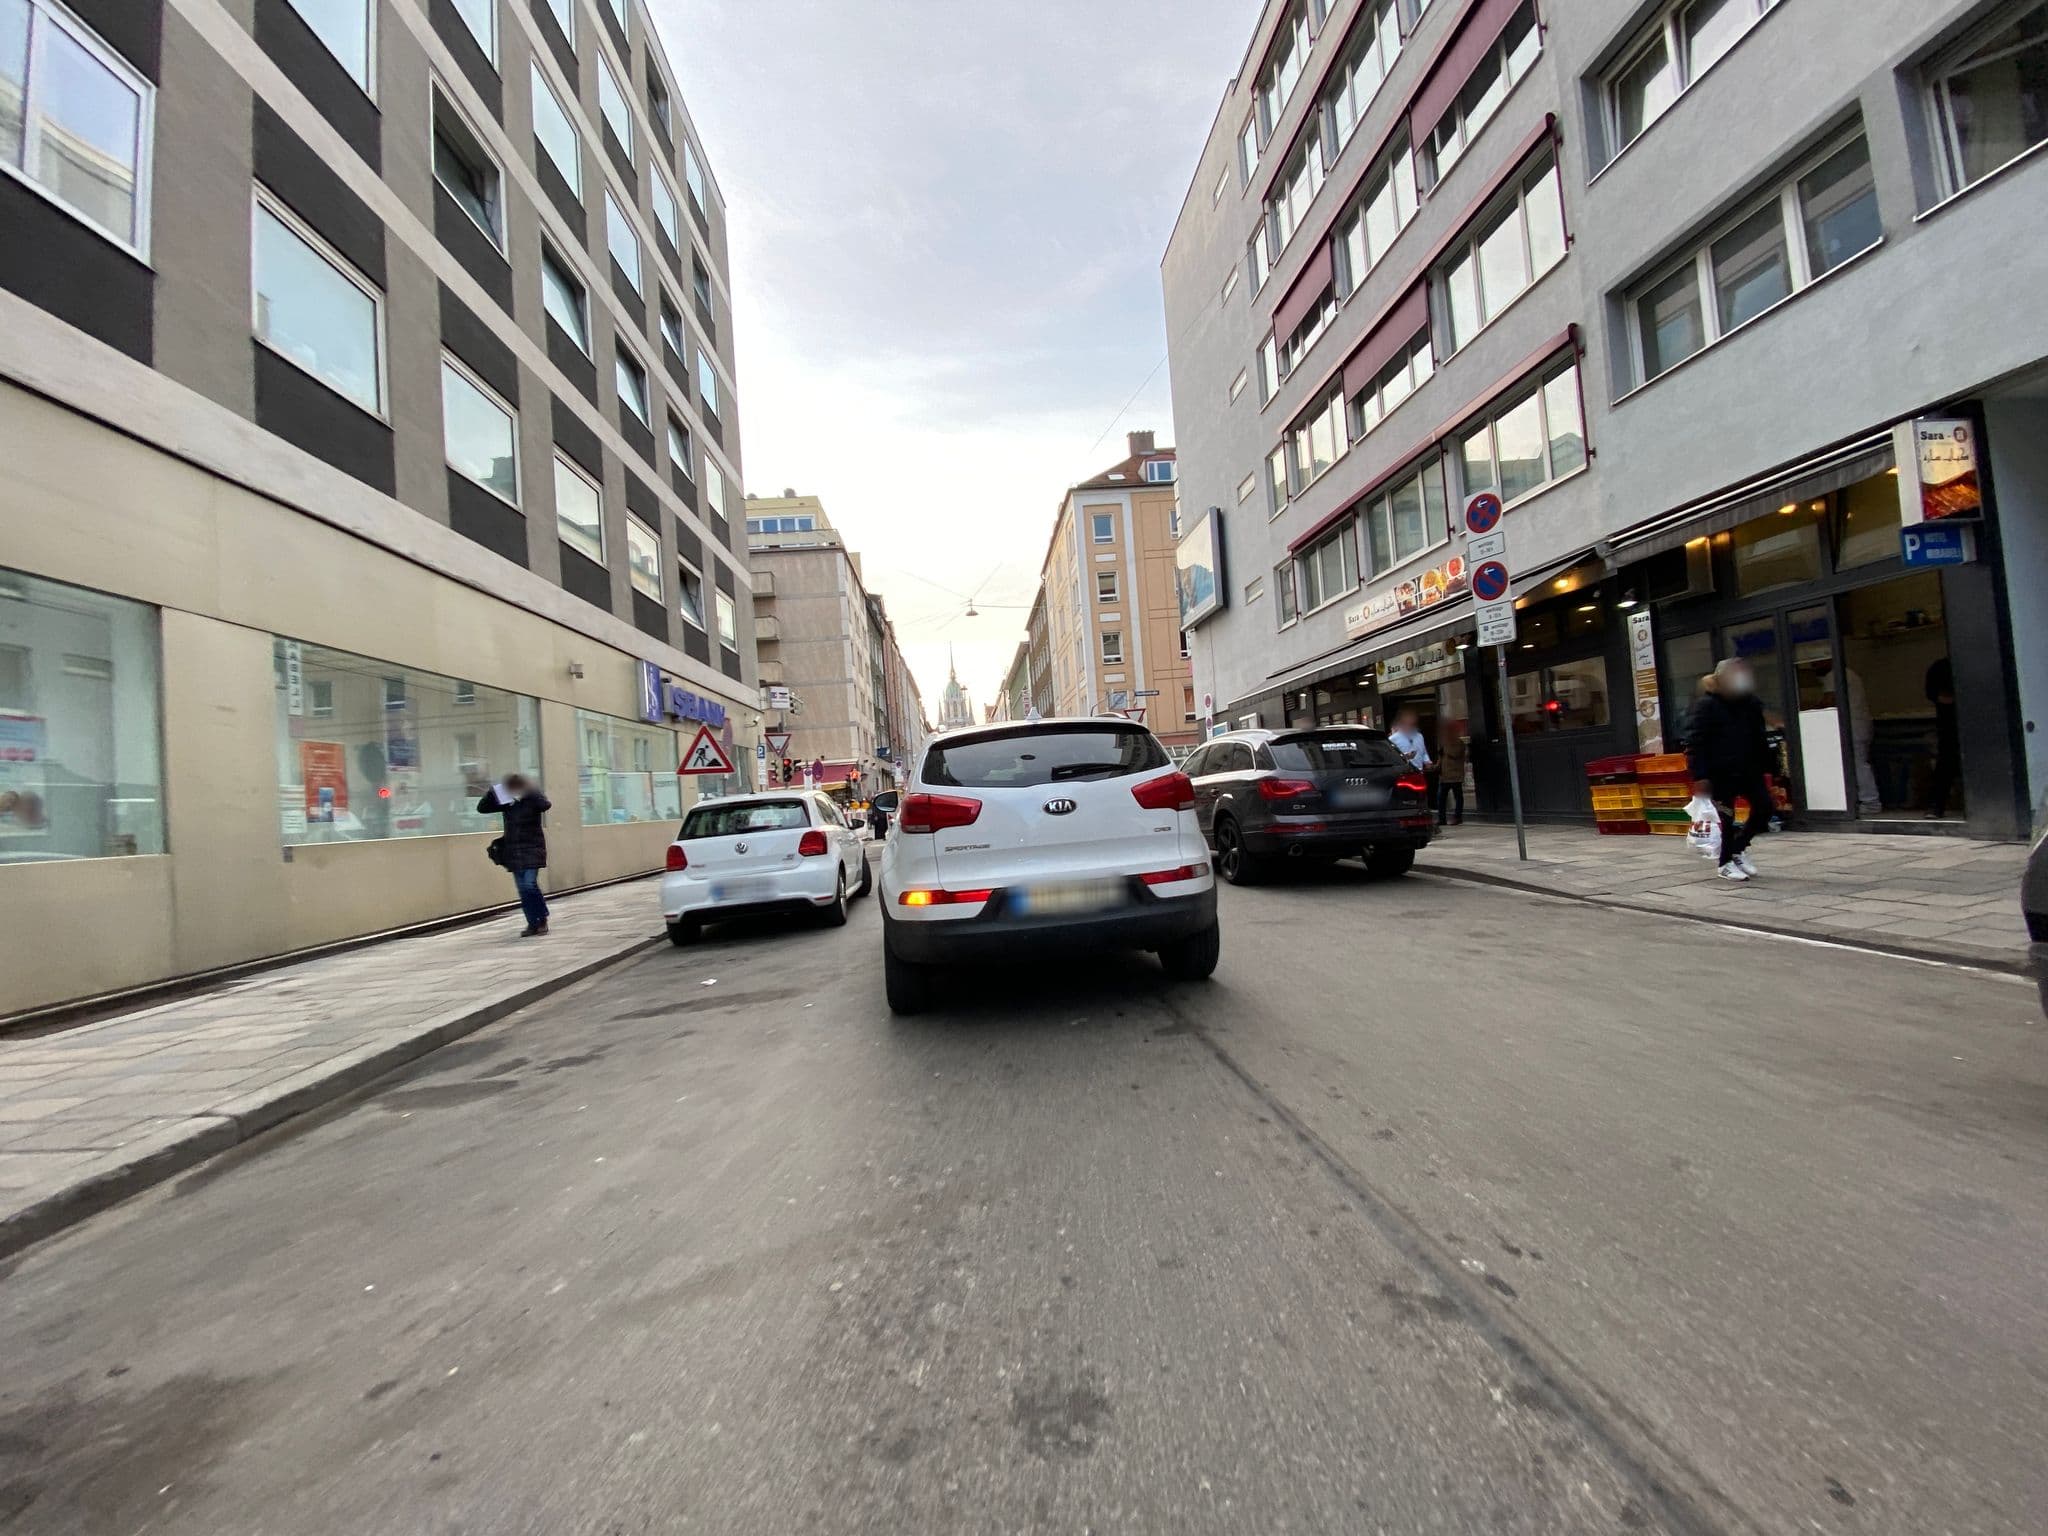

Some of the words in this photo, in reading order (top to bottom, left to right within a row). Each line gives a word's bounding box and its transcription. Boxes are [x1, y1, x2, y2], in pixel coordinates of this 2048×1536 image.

[1920, 431, 1944, 440] Sara
[1904, 534, 1920, 560] P
[1632, 616, 1650, 624] Sara
[1048, 800, 1073, 812] KIA
